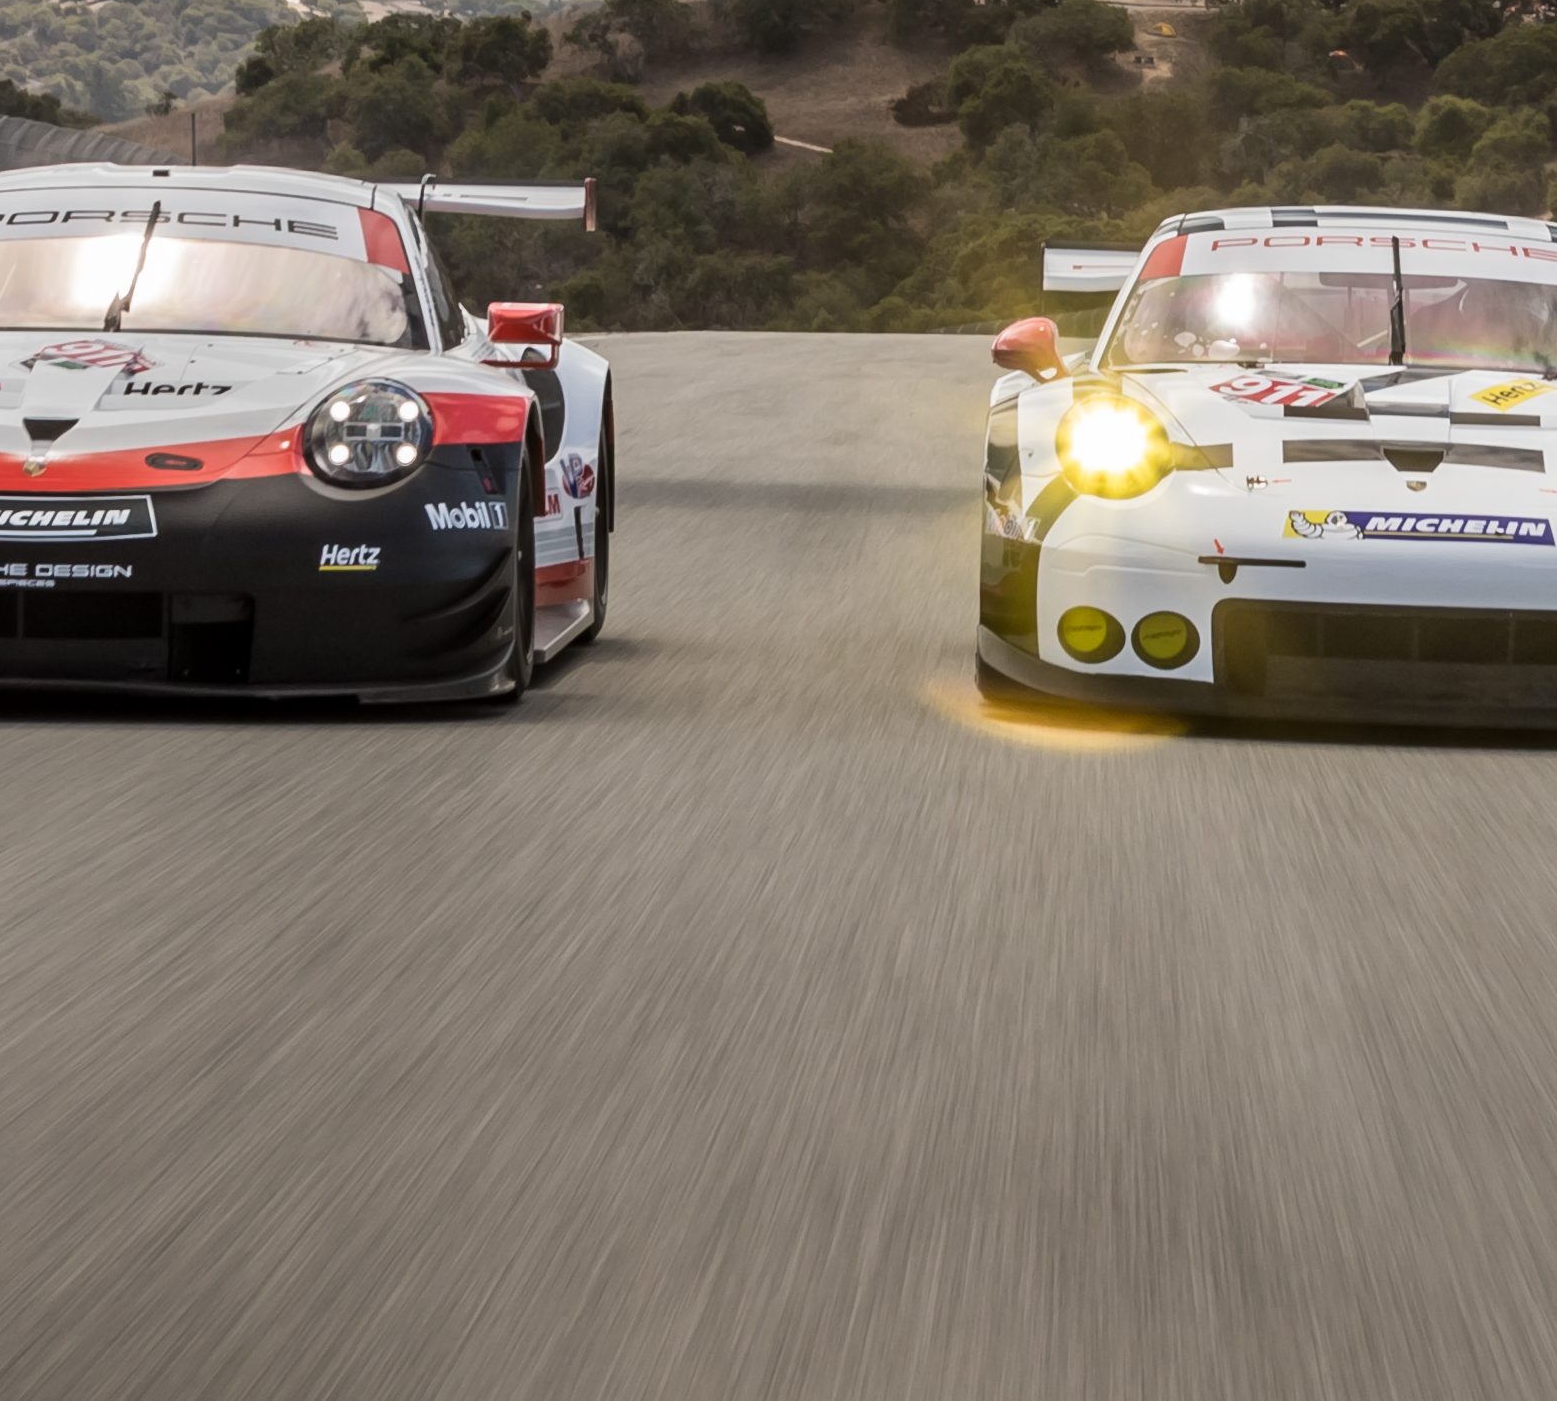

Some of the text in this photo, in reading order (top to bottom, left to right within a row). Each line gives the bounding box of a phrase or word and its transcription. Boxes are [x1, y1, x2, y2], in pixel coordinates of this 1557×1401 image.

[123, 382, 233, 396] Hertz
[1219, 374, 1330, 407] 911
[424, 501, 491, 530] Mobil
[1365, 516, 1547, 537] MICHELIN
[320, 544, 381, 565] Hertz
[35, 564, 133, 578] DESIGN
